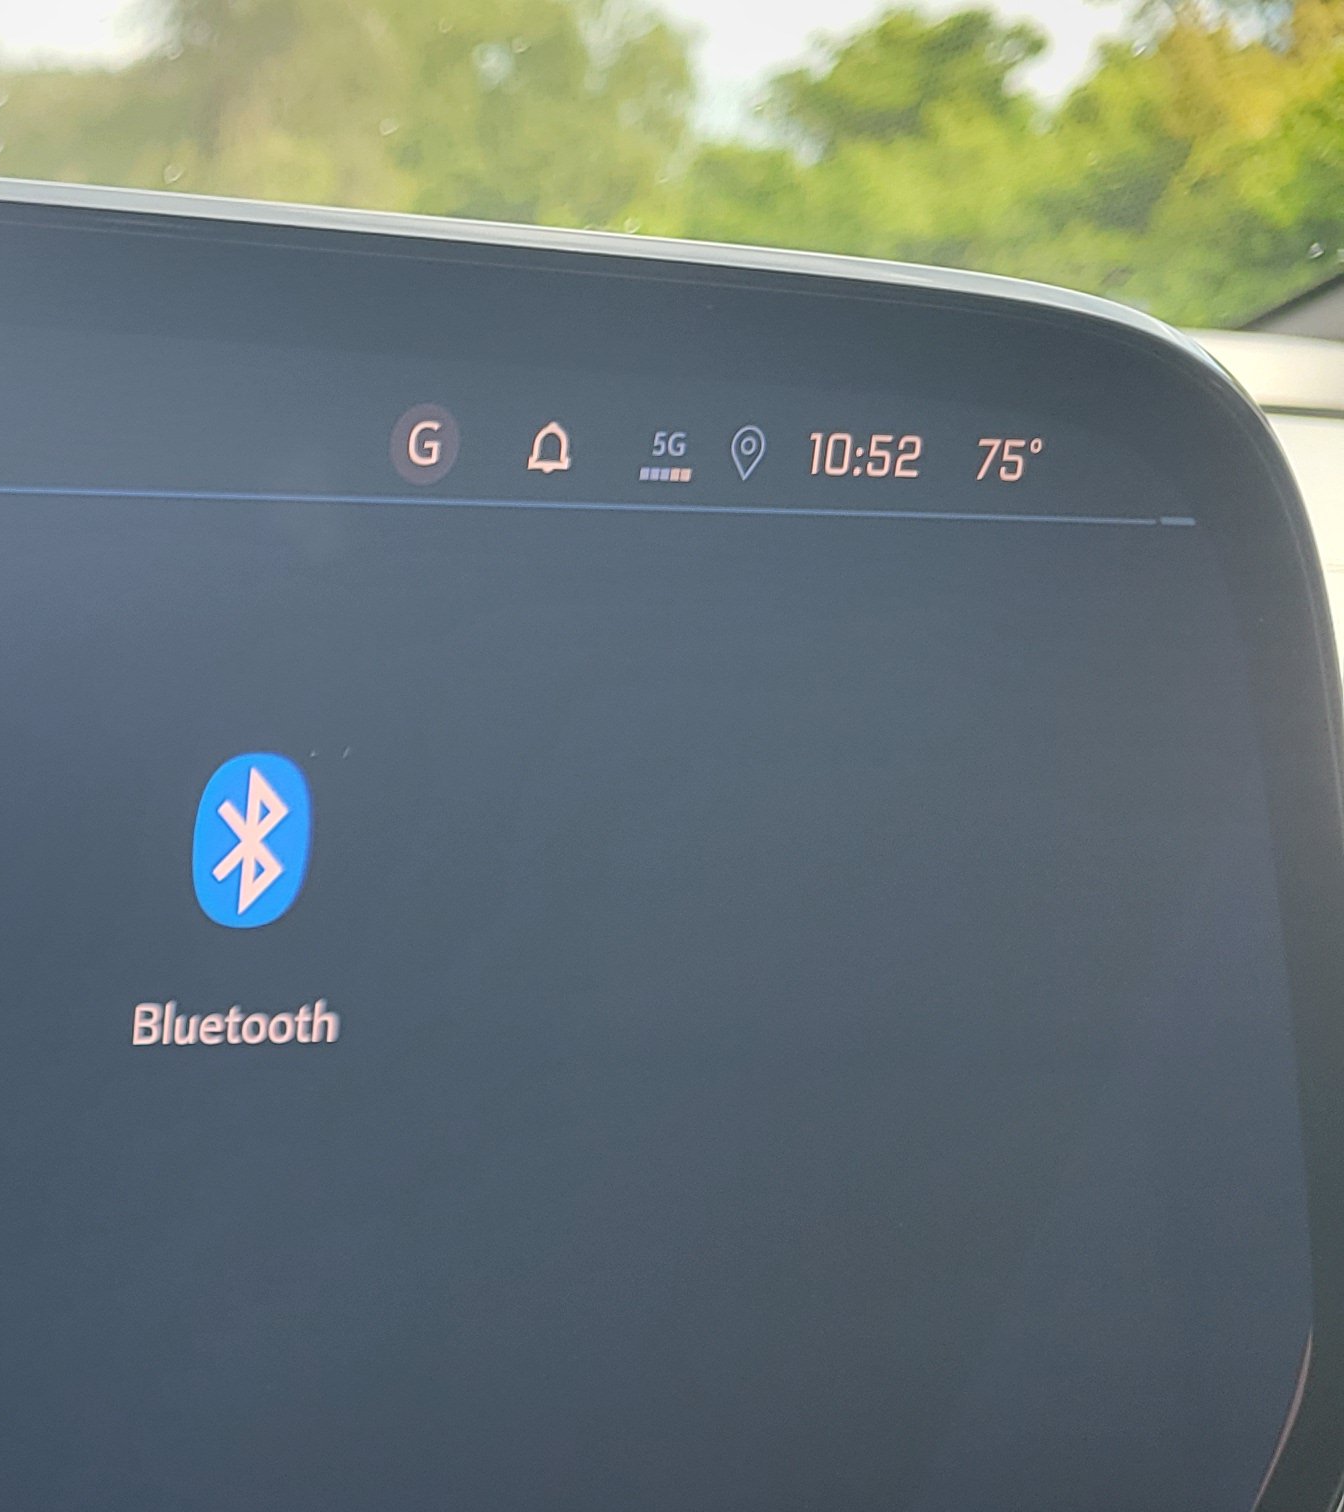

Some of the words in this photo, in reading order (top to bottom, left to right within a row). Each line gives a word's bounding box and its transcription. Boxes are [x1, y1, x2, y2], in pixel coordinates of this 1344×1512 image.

[408, 421, 440, 466] G
[652, 431, 686, 457] 5G
[810, 432, 922, 478] 10:52
[976, 438, 1042, 481] 75°
[132, 1000, 338, 1045] Bluetooth
